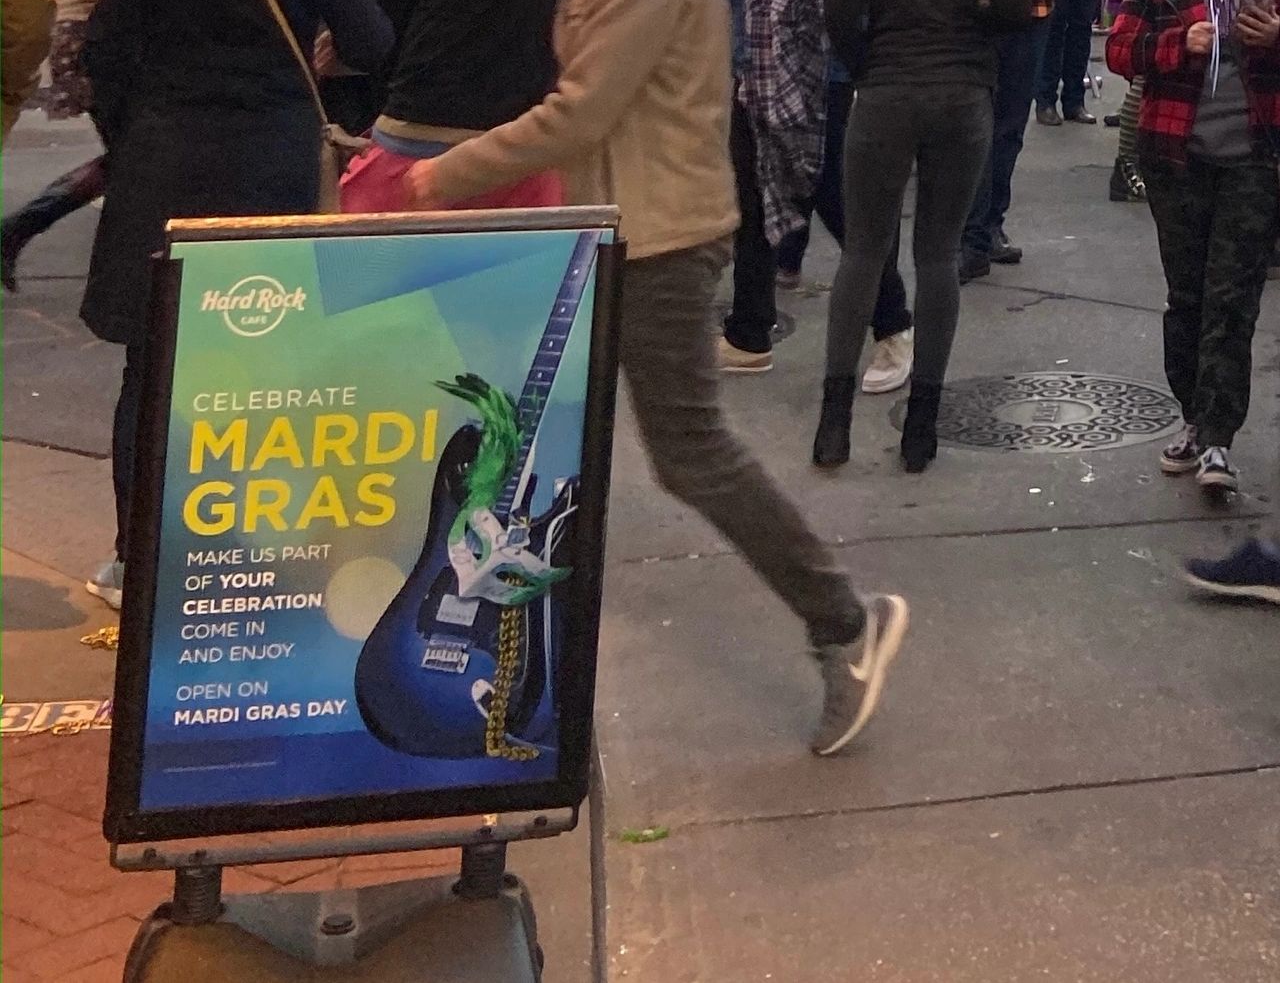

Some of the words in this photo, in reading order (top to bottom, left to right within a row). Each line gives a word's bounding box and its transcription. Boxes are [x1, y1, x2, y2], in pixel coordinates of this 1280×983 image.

[200, 288, 256, 311] Hard
[256, 286, 307, 313] Rock
[240, 315, 268, 325] CAFE
[193, 386, 357, 412] CELEBRATE
[188, 408, 439, 475] MARDI
[183, 473, 397, 536] GRAS
[187, 548, 244, 567] MAKE
[250, 547, 276, 563] US
[282, 544, 332, 561] PART
[185, 574, 213, 591] OF
[219, 571, 275, 589] YOUR
[181, 621, 239, 640] COME
[245, 621, 265, 636] IN
[178, 647, 223, 665] AND
[176, 682, 231, 702] OPEN
[237, 681, 268, 698] ON
[174, 708, 239, 726] MARDI
[246, 703, 301, 721] GRAS
